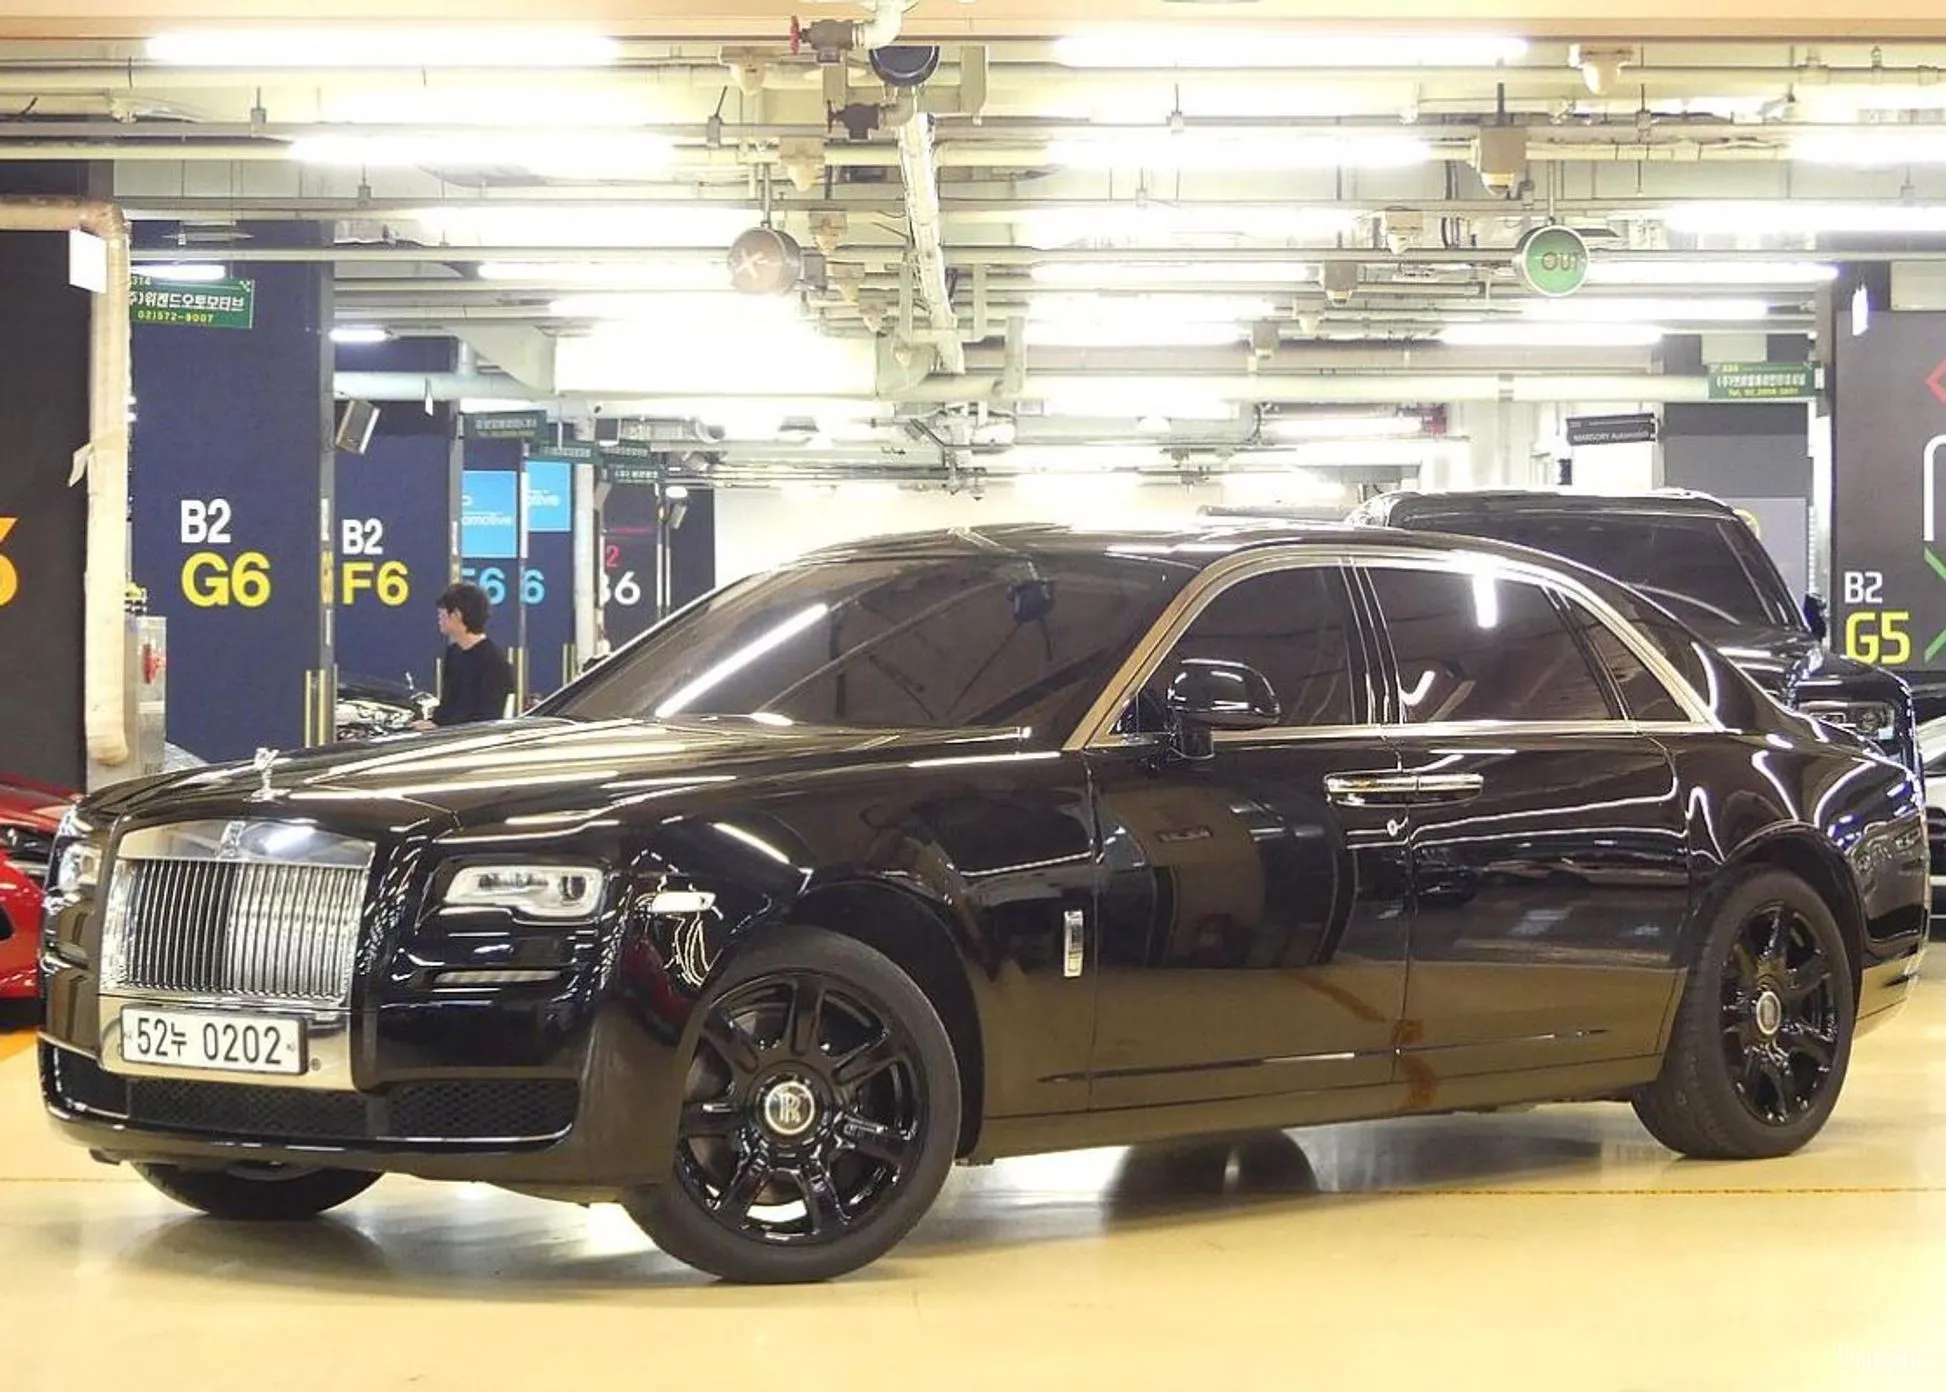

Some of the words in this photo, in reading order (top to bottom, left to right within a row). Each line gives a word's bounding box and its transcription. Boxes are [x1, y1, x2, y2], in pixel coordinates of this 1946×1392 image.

[181, 498, 232, 543] B2
[342, 517, 384, 555] B2
[181, 551, 271, 608] G6
[342, 560, 409, 606] F6
[1844, 571, 1883, 604] B2
[1845, 611, 1911, 664] G5
[137, 1017, 187, 1057] 52누
[203, 1022, 282, 1065] 0202
